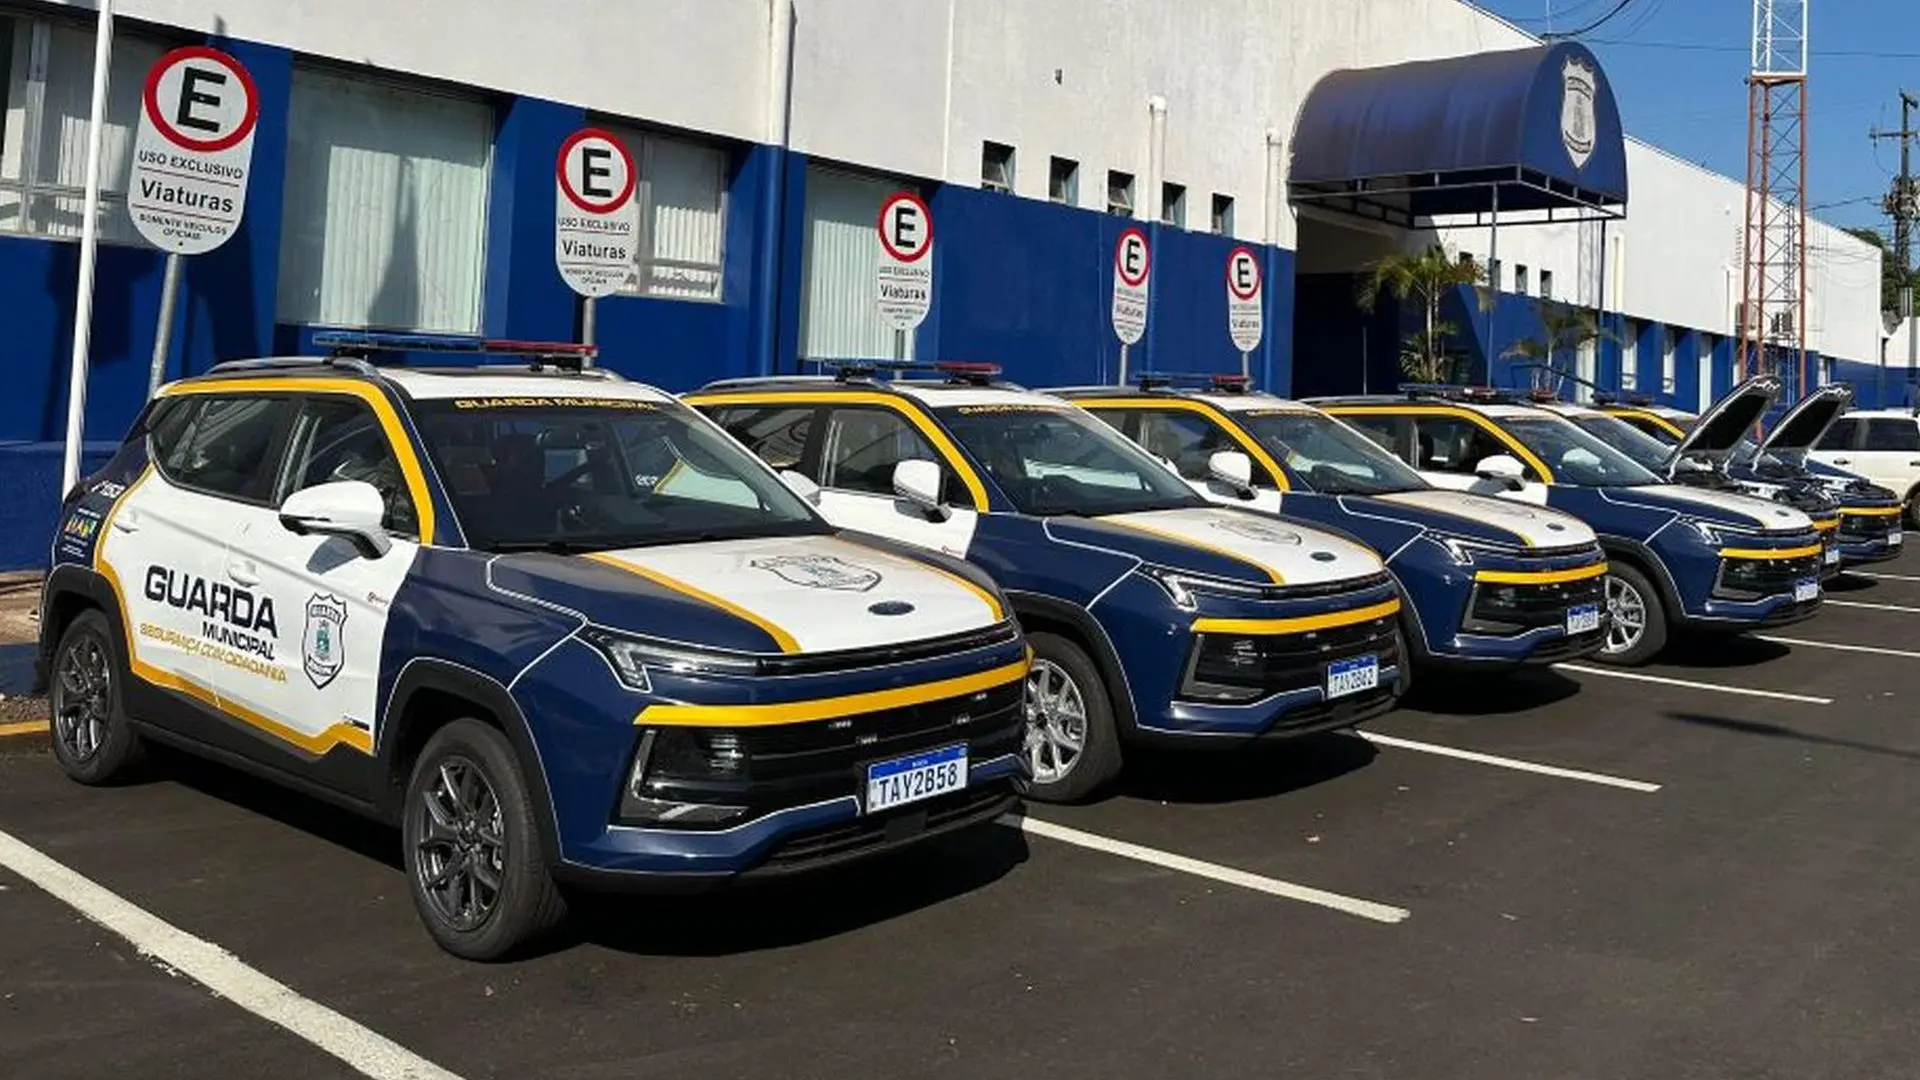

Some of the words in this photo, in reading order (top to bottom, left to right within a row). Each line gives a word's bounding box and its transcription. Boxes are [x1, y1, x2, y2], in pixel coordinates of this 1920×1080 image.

[177, 66, 227, 133] E
[139, 150, 167, 167] USO
[170, 155, 244, 179] EXCLUSIVO
[582, 147, 613, 198] E
[141, 178, 233, 213] Viaturas
[559, 217, 578, 227] USO
[895, 206, 916, 248] E
[562, 239, 626, 260] Viaturas
[1126, 238, 1141, 276] E
[880, 283, 927, 300] Viaturas
[1237, 257, 1251, 289] E
[454, 398, 550, 410] GUARDA
[144, 564, 279, 640] GUARDA
[140, 622, 202, 656] SEGURANÇA
[223, 652, 286, 683] CIDADANIA
[202, 620, 276, 661] MUNICIPAL
[879, 762, 958, 806] TAY2B58
